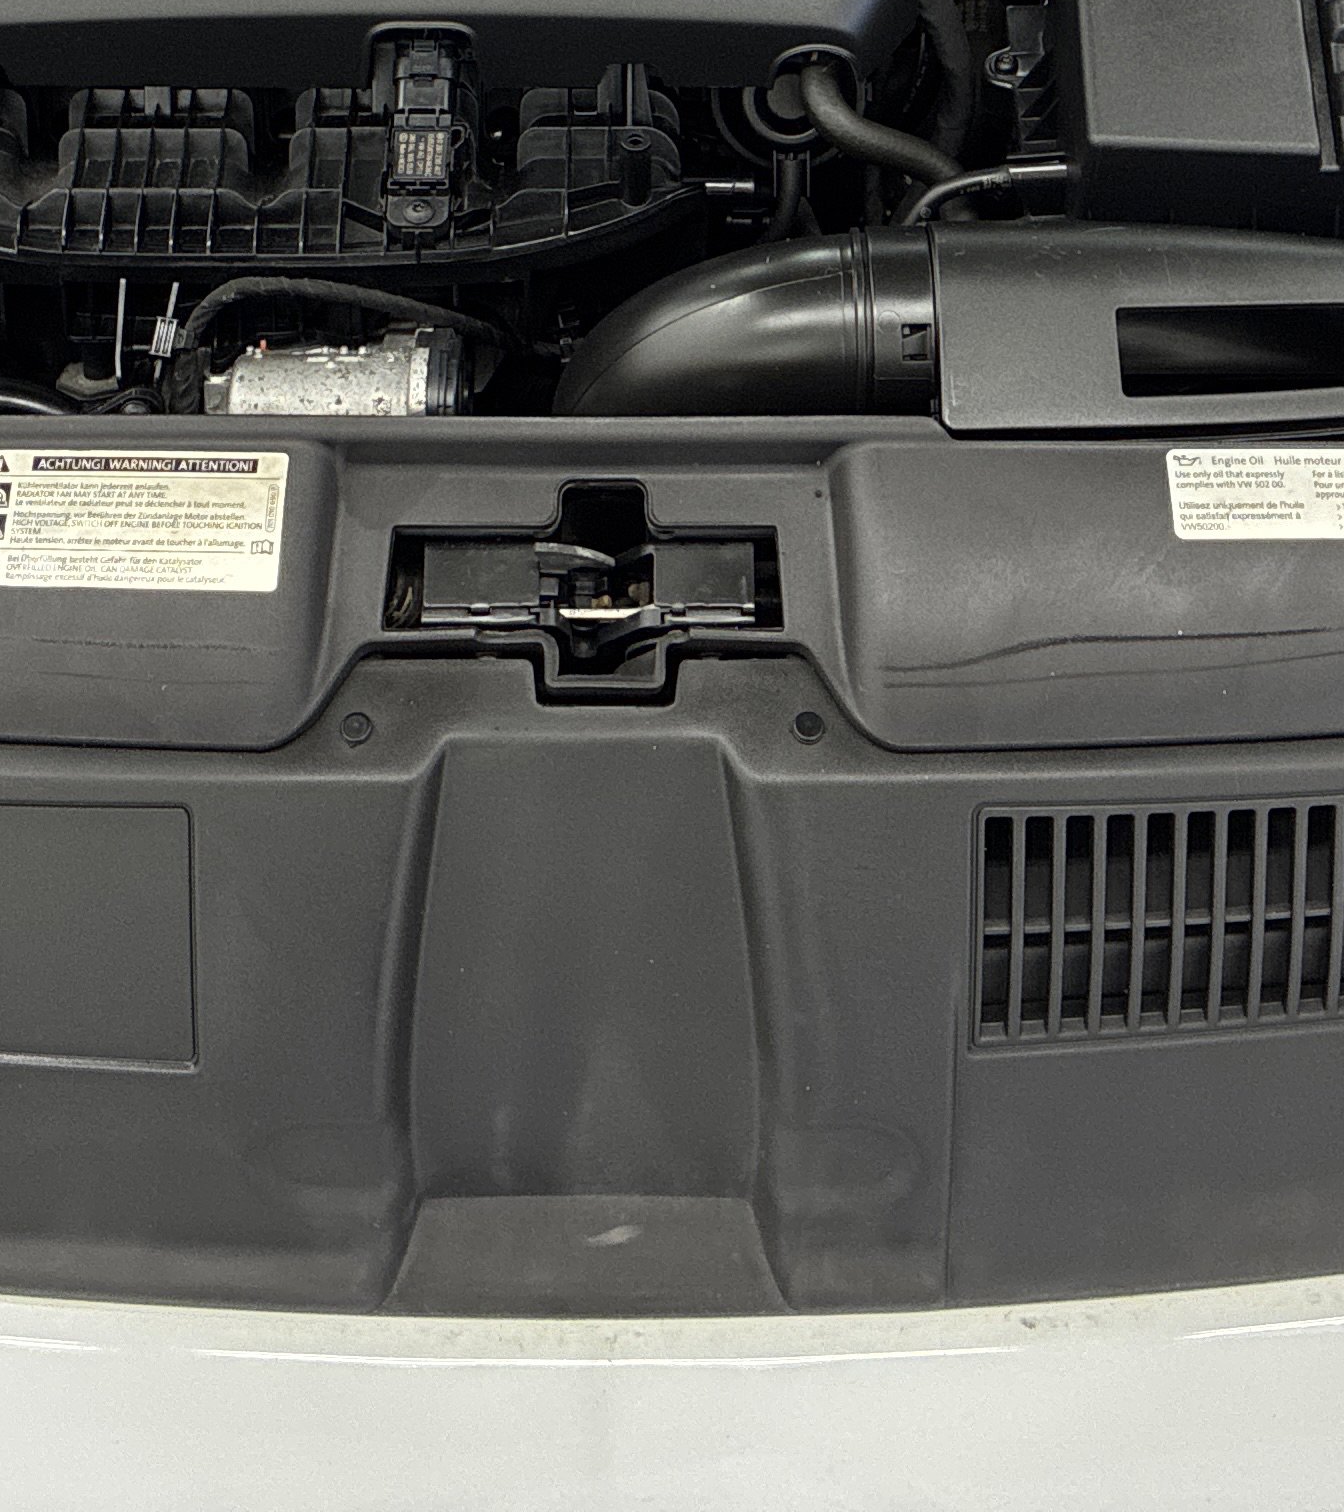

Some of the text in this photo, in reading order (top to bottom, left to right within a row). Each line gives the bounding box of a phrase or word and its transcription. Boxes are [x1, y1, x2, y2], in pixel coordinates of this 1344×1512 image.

[37, 459, 254, 472] ACHTUNG! WARNING! ATTENTION!
[1211, 456, 1264, 467] Engine Oil
[1273, 456, 1341, 466] Huile moteur
